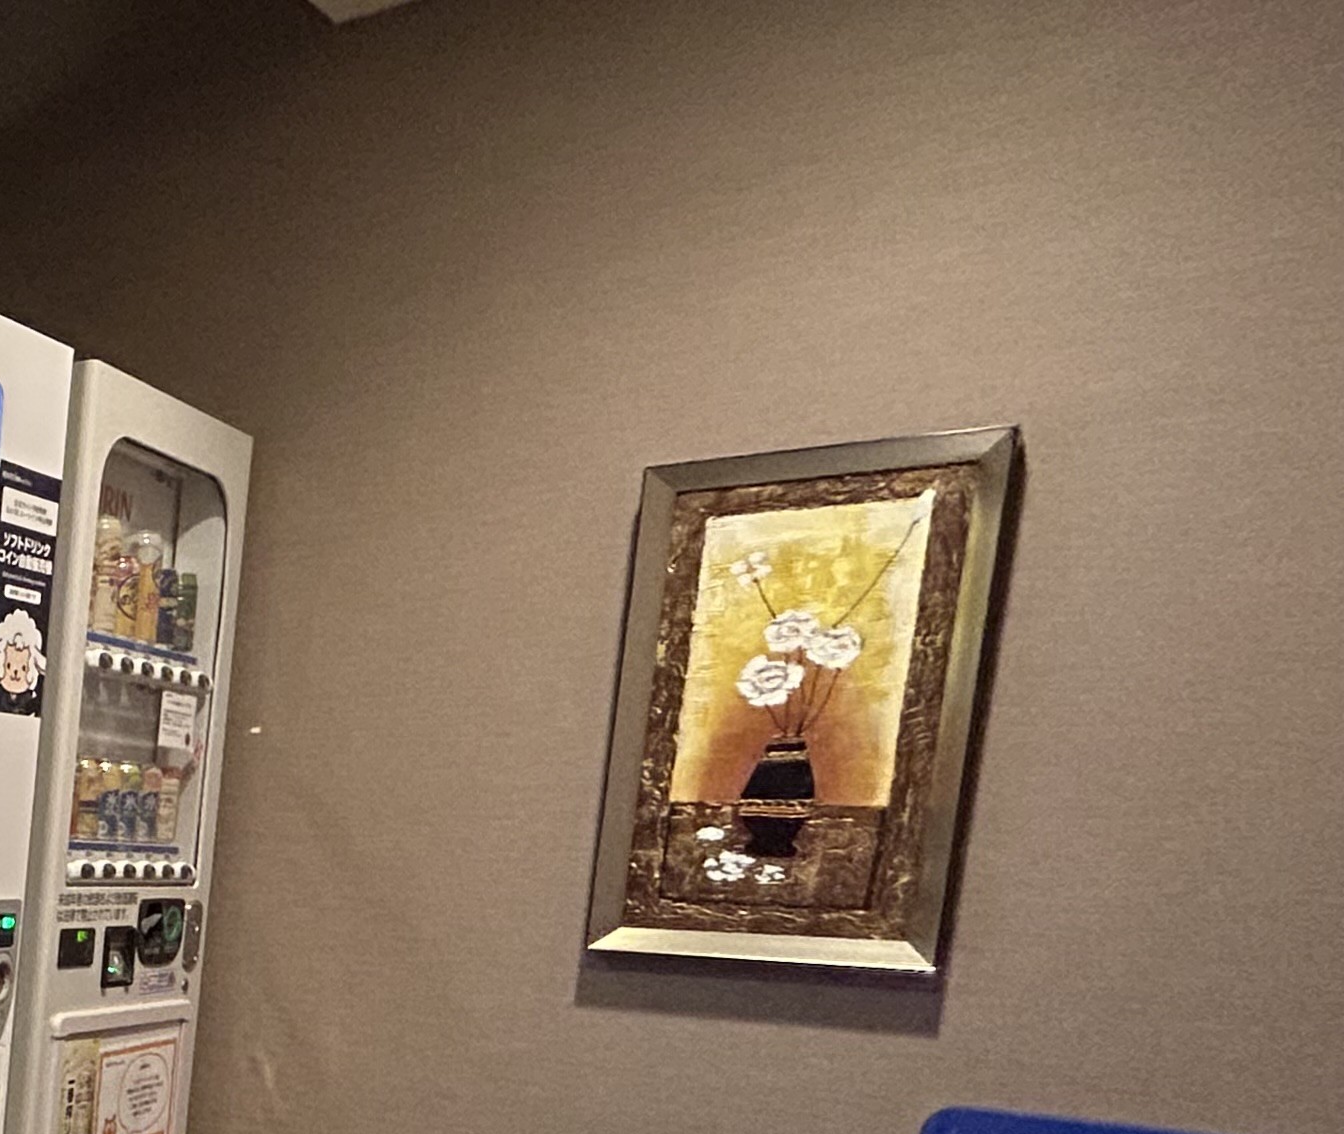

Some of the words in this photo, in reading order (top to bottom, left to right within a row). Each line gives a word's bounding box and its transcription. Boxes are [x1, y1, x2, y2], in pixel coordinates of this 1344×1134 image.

[3, 531, 51, 557] ソフトドリンク
